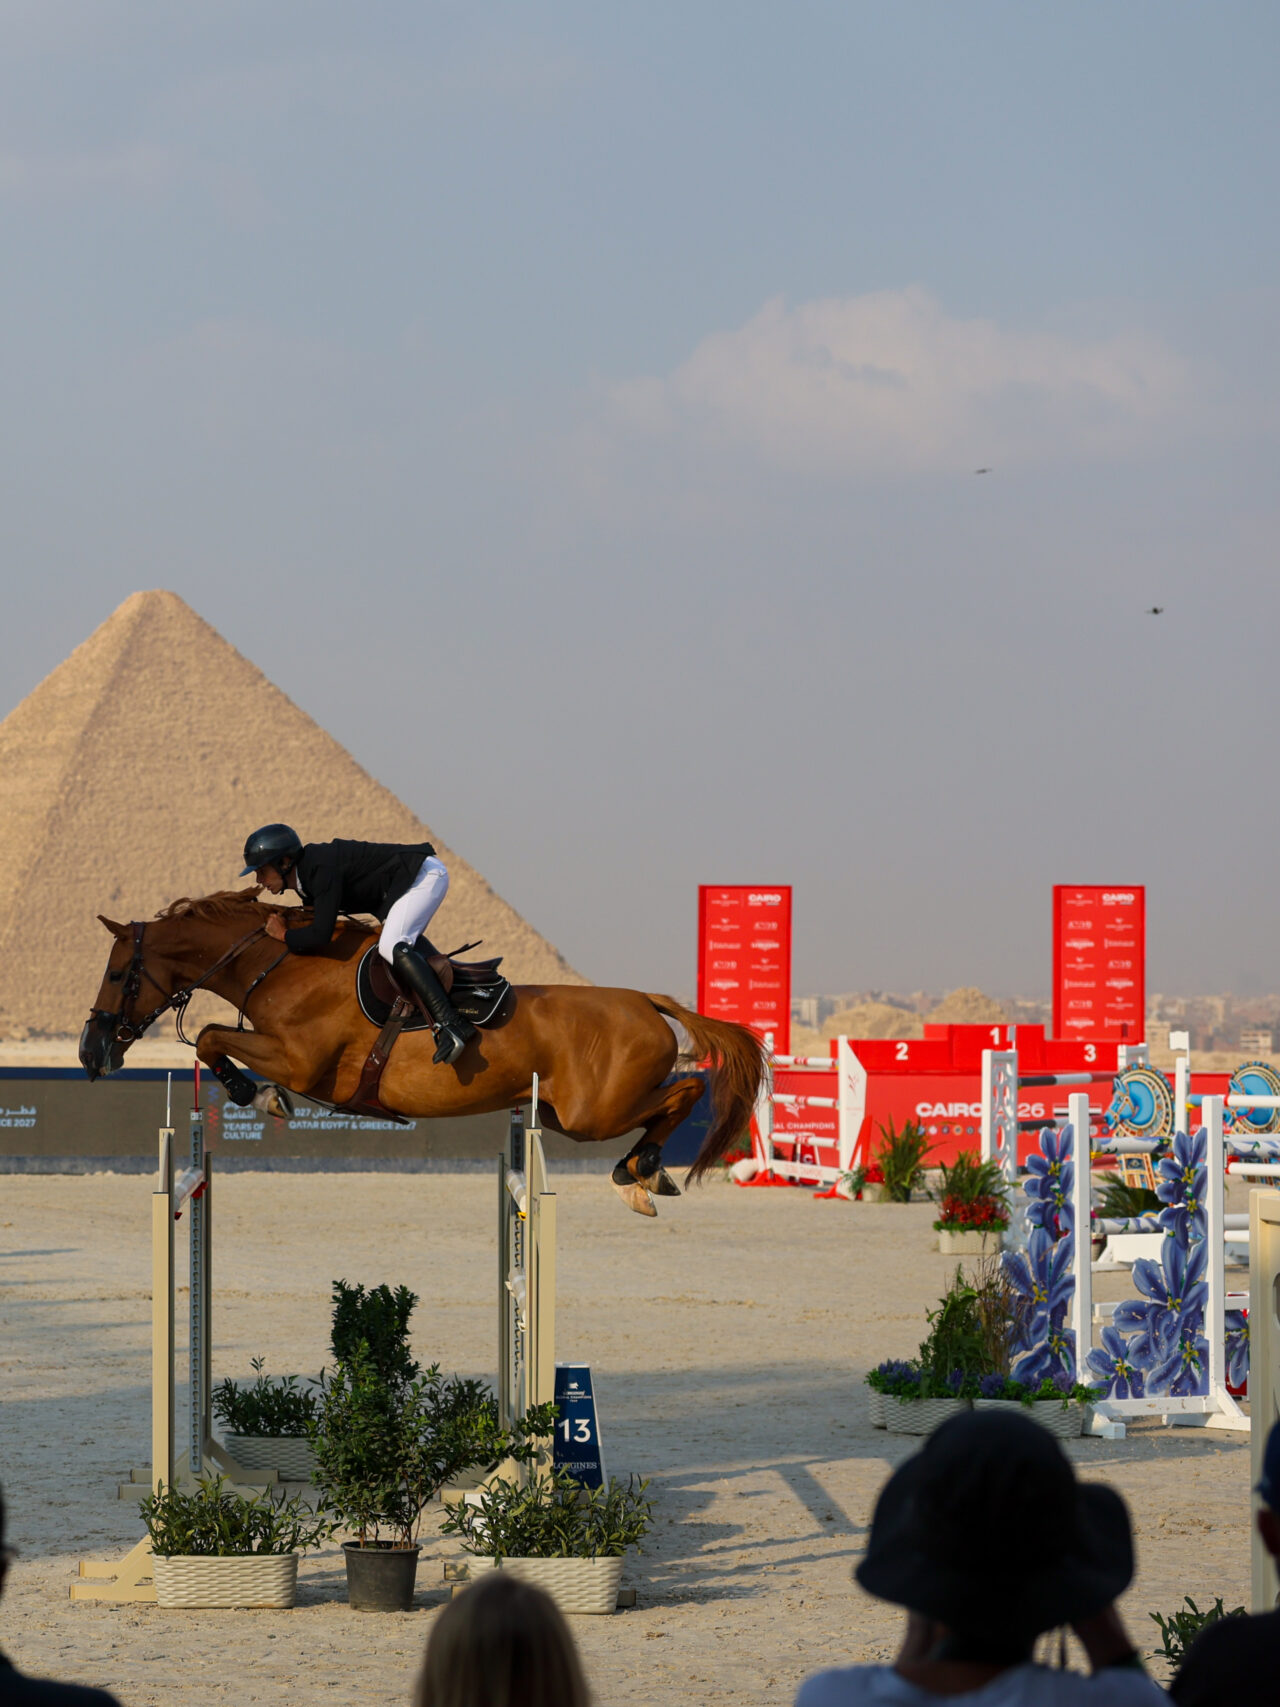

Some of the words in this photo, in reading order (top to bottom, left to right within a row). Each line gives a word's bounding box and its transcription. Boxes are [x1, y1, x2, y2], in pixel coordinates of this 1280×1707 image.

[990, 1027, 1000, 1045] 1
[895, 1042, 909, 1060] 2
[1084, 1044, 1096, 1062] 3
[294, 1108, 311, 1117] 027
[915, 1102, 982, 1118] CAIRO
[1017, 1102, 1045, 1118] 26
[13, 1118, 36, 1127] 2027
[223, 1122, 252, 1131] YEARS
[253, 1122, 265, 1131] OF
[289, 1121, 319, 1130] QATAR
[321, 1121, 349, 1130] EGYPT
[351, 1121, 358, 1130] &
[359, 1121, 393, 1130] GREECE
[787, 1122, 835, 1130] CHAMPIONS
[223, 1131, 262, 1140] CULTURE
[558, 1418, 591, 1443] 13
